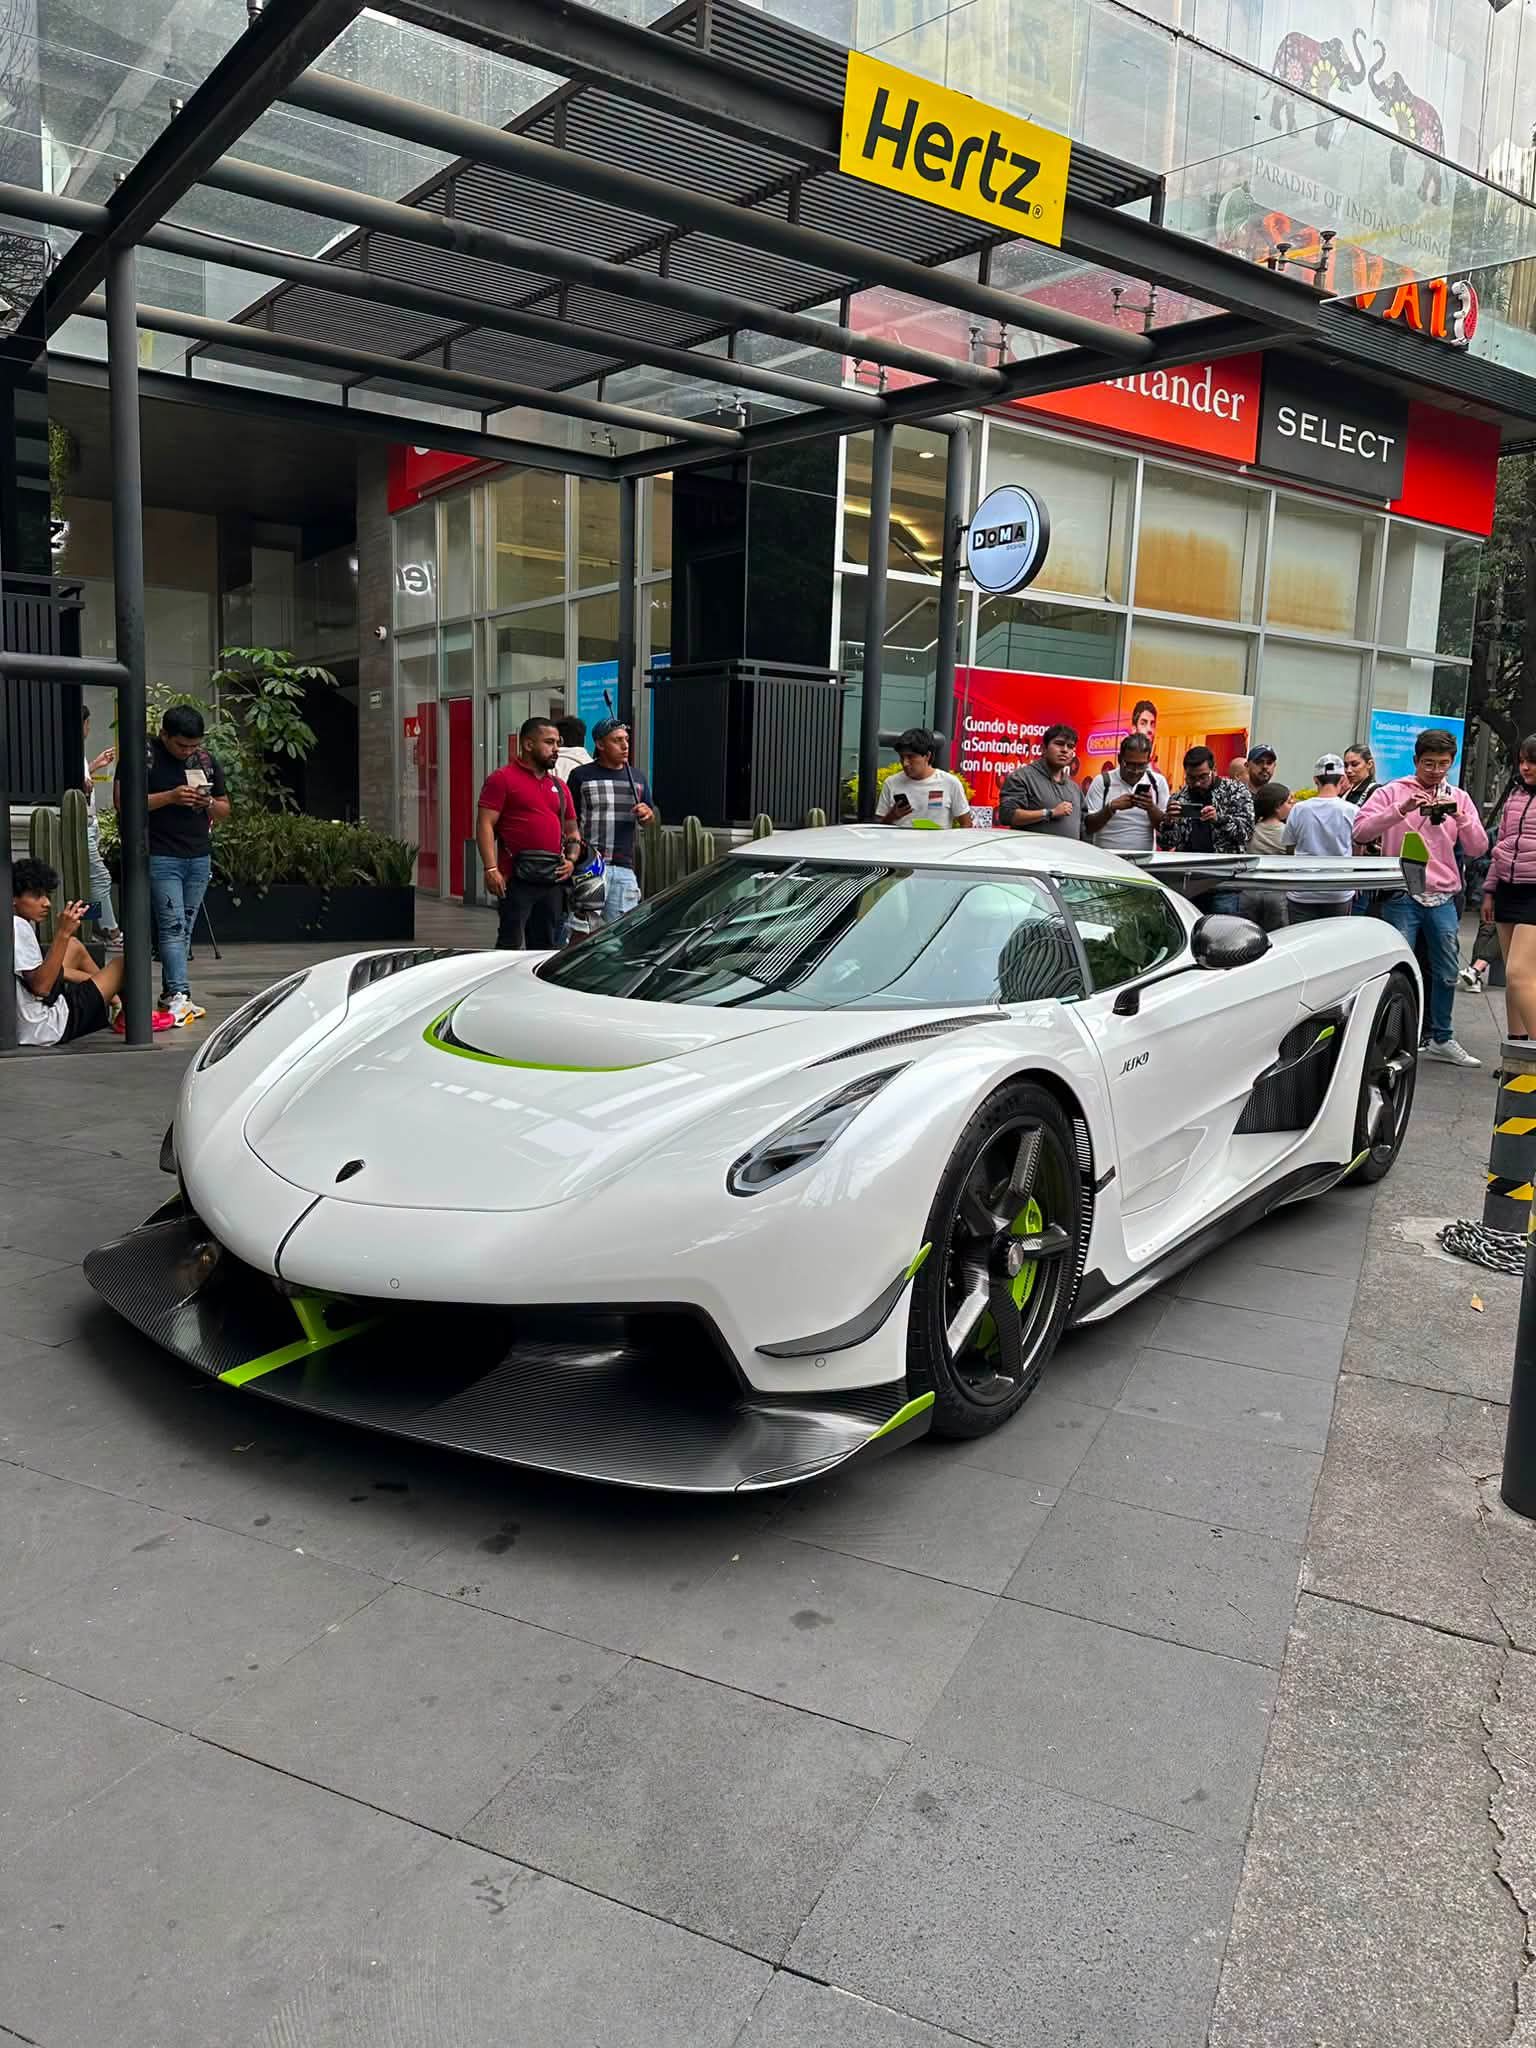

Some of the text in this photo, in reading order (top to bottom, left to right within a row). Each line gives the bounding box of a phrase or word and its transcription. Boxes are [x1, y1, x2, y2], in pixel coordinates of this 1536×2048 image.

[862, 87, 1041, 215] Hertz
[1255, 156, 1449, 259] PARADISE OF INDIAN CUISINE
[1102, 366, 1395, 463] tander SELECT
[974, 525, 1025, 548] DOMA
[964, 716, 1005, 733] Cuando
[1007, 720, 1018, 734] te
[963, 740, 970, 751] a
[972, 737, 1029, 756] Santander,
[962, 759, 980, 771] con
[982, 757, 992, 772] lo
[995, 761, 1015, 776] que
